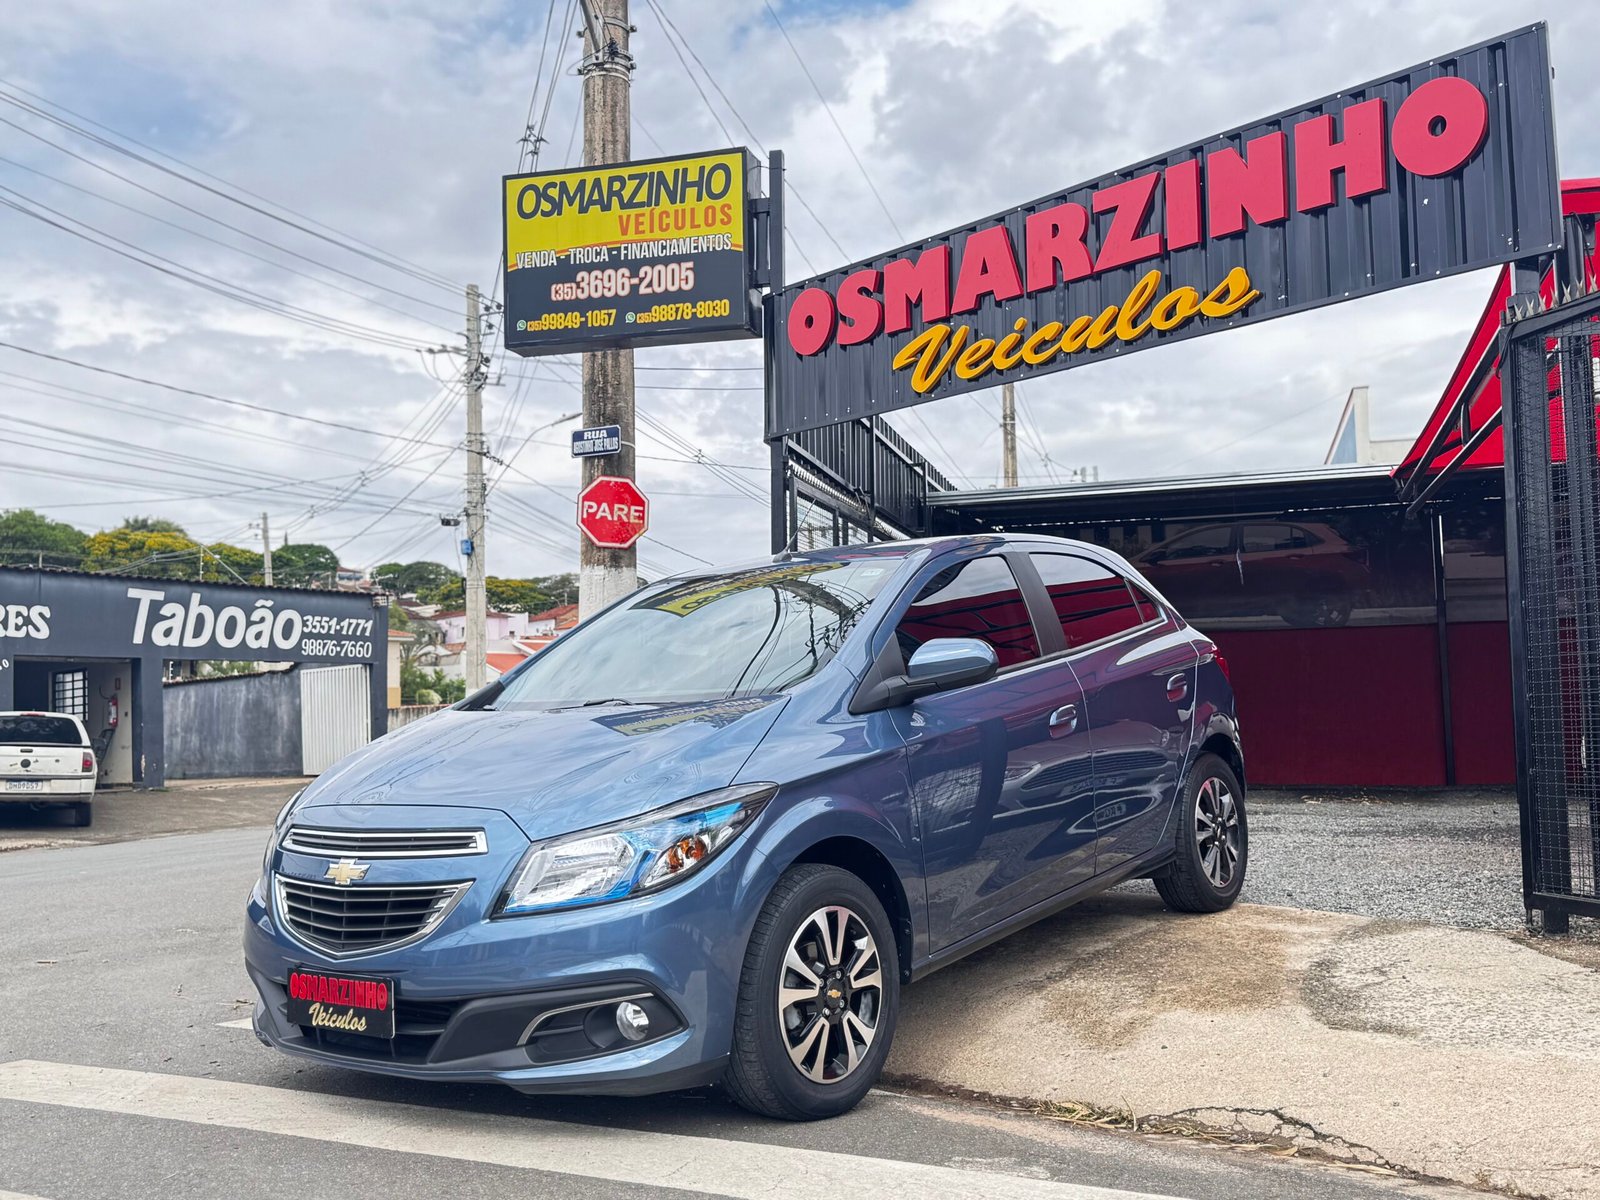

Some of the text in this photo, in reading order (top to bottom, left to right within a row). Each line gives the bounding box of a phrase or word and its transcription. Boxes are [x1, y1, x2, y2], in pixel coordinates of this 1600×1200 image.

[517, 162, 732, 219] OSMARZINHO
[618, 203, 733, 236] VEÍCULOS
[787, 75, 1488, 357] OSMARZINHO
[516, 250, 557, 269] VENDA
[569, 245, 609, 265] TROCA
[621, 233, 732, 260] FINANCIAMENTOS
[551, 261, 695, 301] (35)3696-2005
[584, 429, 608, 440] RUA
[582, 500, 644, 524] PARE
[127, 587, 303, 650] Taboão
[290, 972, 388, 1011] OSMARZINHO
